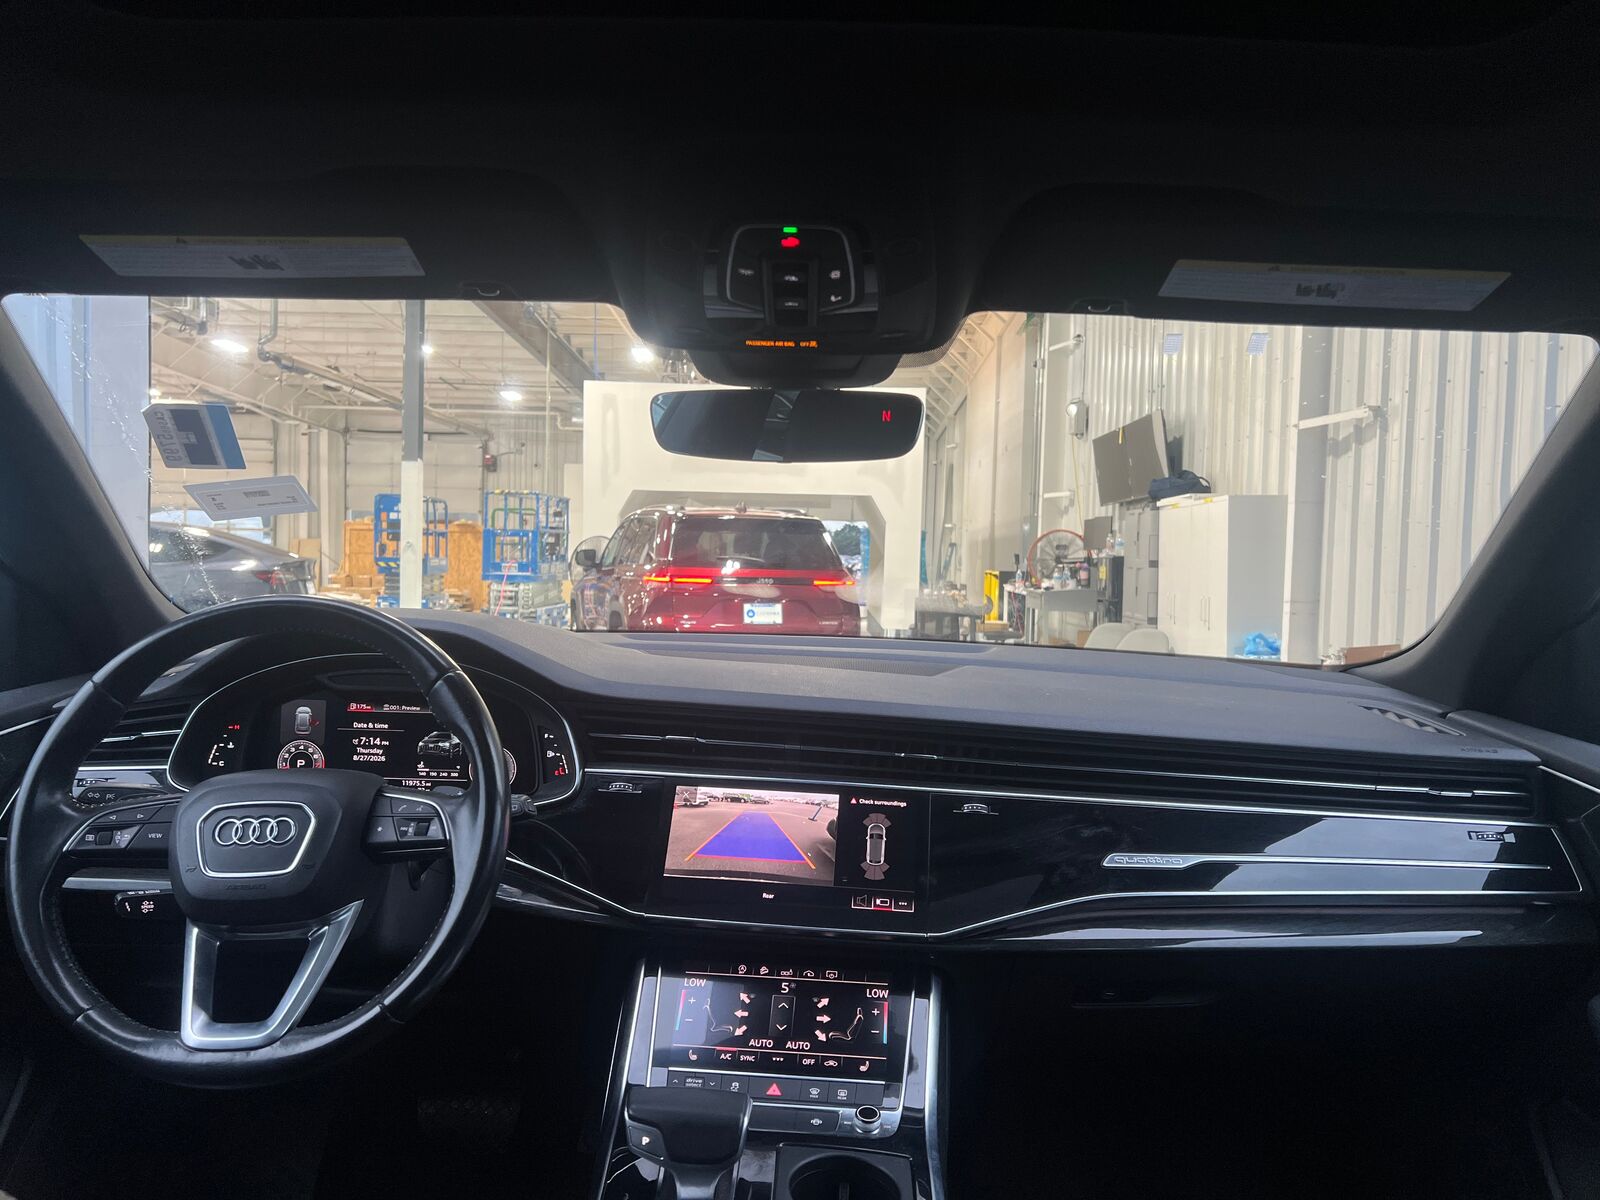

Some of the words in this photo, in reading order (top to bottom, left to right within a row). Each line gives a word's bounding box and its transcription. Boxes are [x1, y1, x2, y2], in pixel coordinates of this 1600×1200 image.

[882, 410, 891, 422] N
[360, 737, 380, 745] 7:14
[296, 760, 306, 768] P
[684, 978, 706, 987] LOW
[781, 982, 789, 993] 5
[866, 989, 889, 998] LOW
[748, 1039, 774, 1048] AUTO
[785, 1041, 810, 1050] AUTO
[642, 1136, 650, 1146] P
